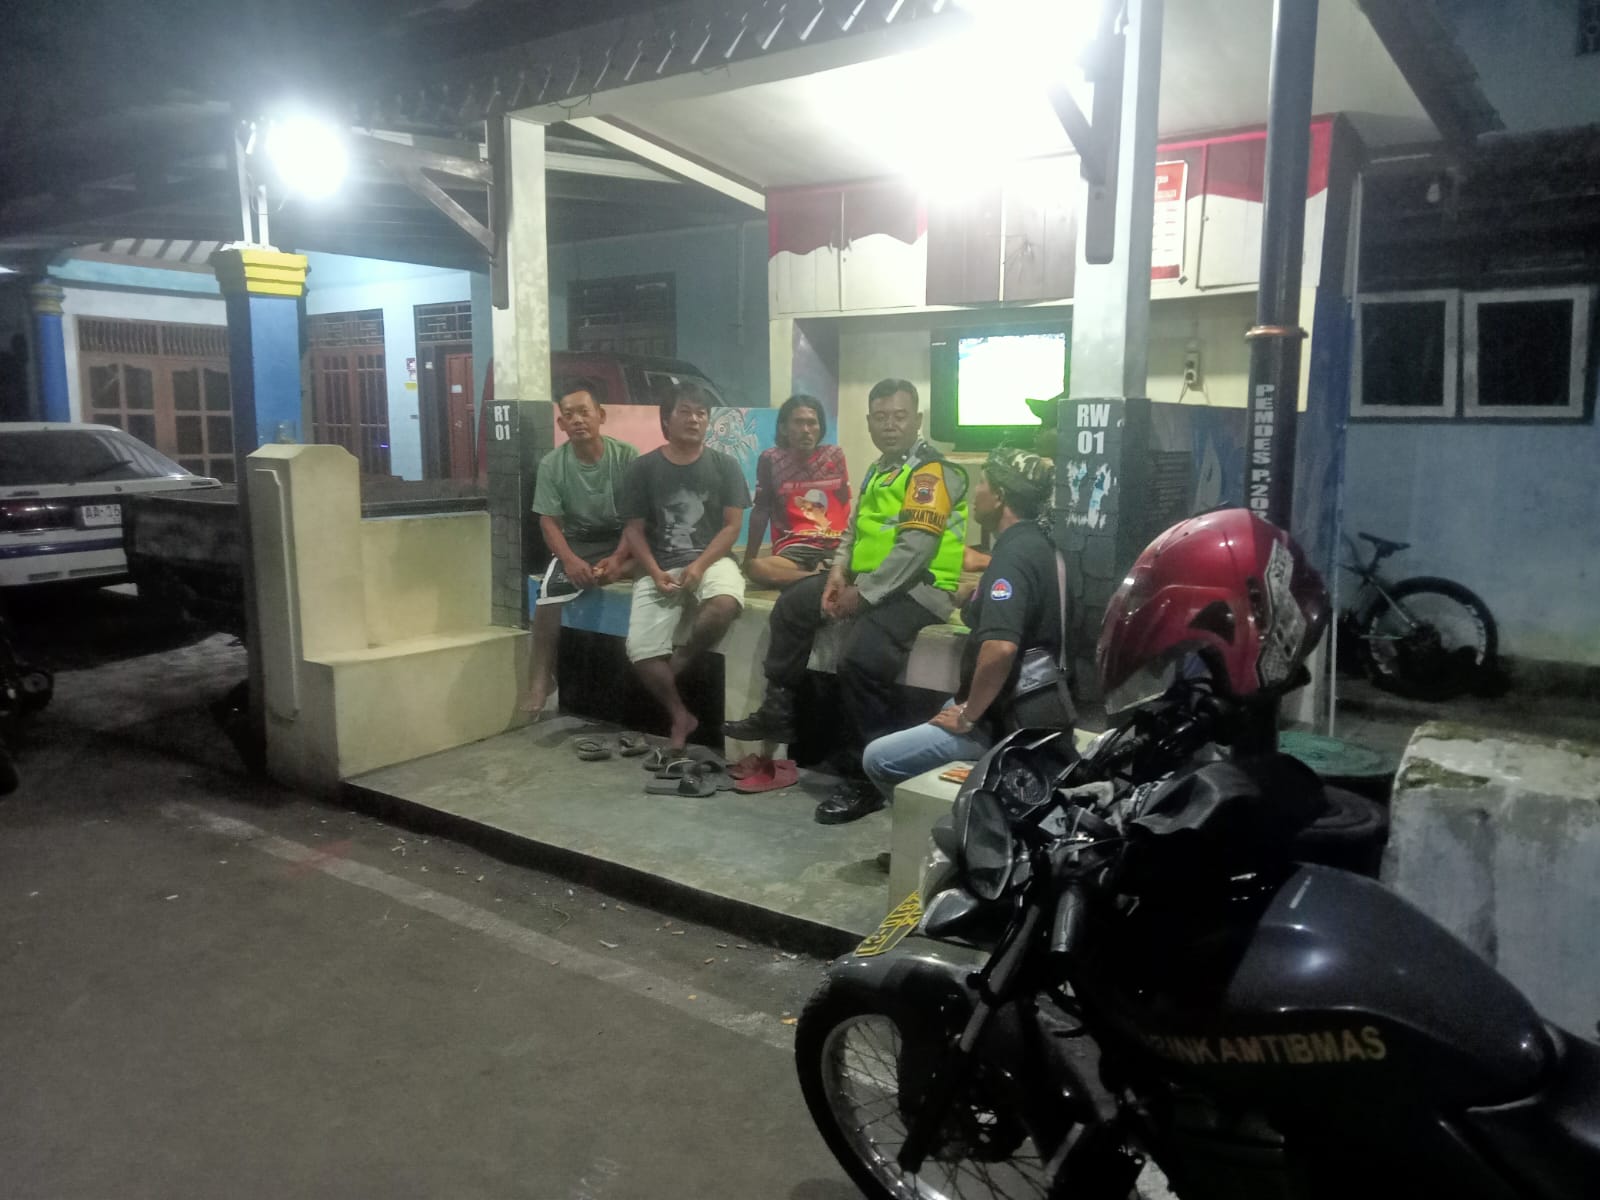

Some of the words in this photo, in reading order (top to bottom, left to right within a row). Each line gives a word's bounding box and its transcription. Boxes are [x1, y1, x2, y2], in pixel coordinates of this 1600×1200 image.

[494, 405, 510, 421] RT
[1077, 404, 1110, 427] RW
[1253, 384, 1275, 465] PEMDES
[495, 424, 510, 440] 01
[1077, 431, 1104, 454] 01
